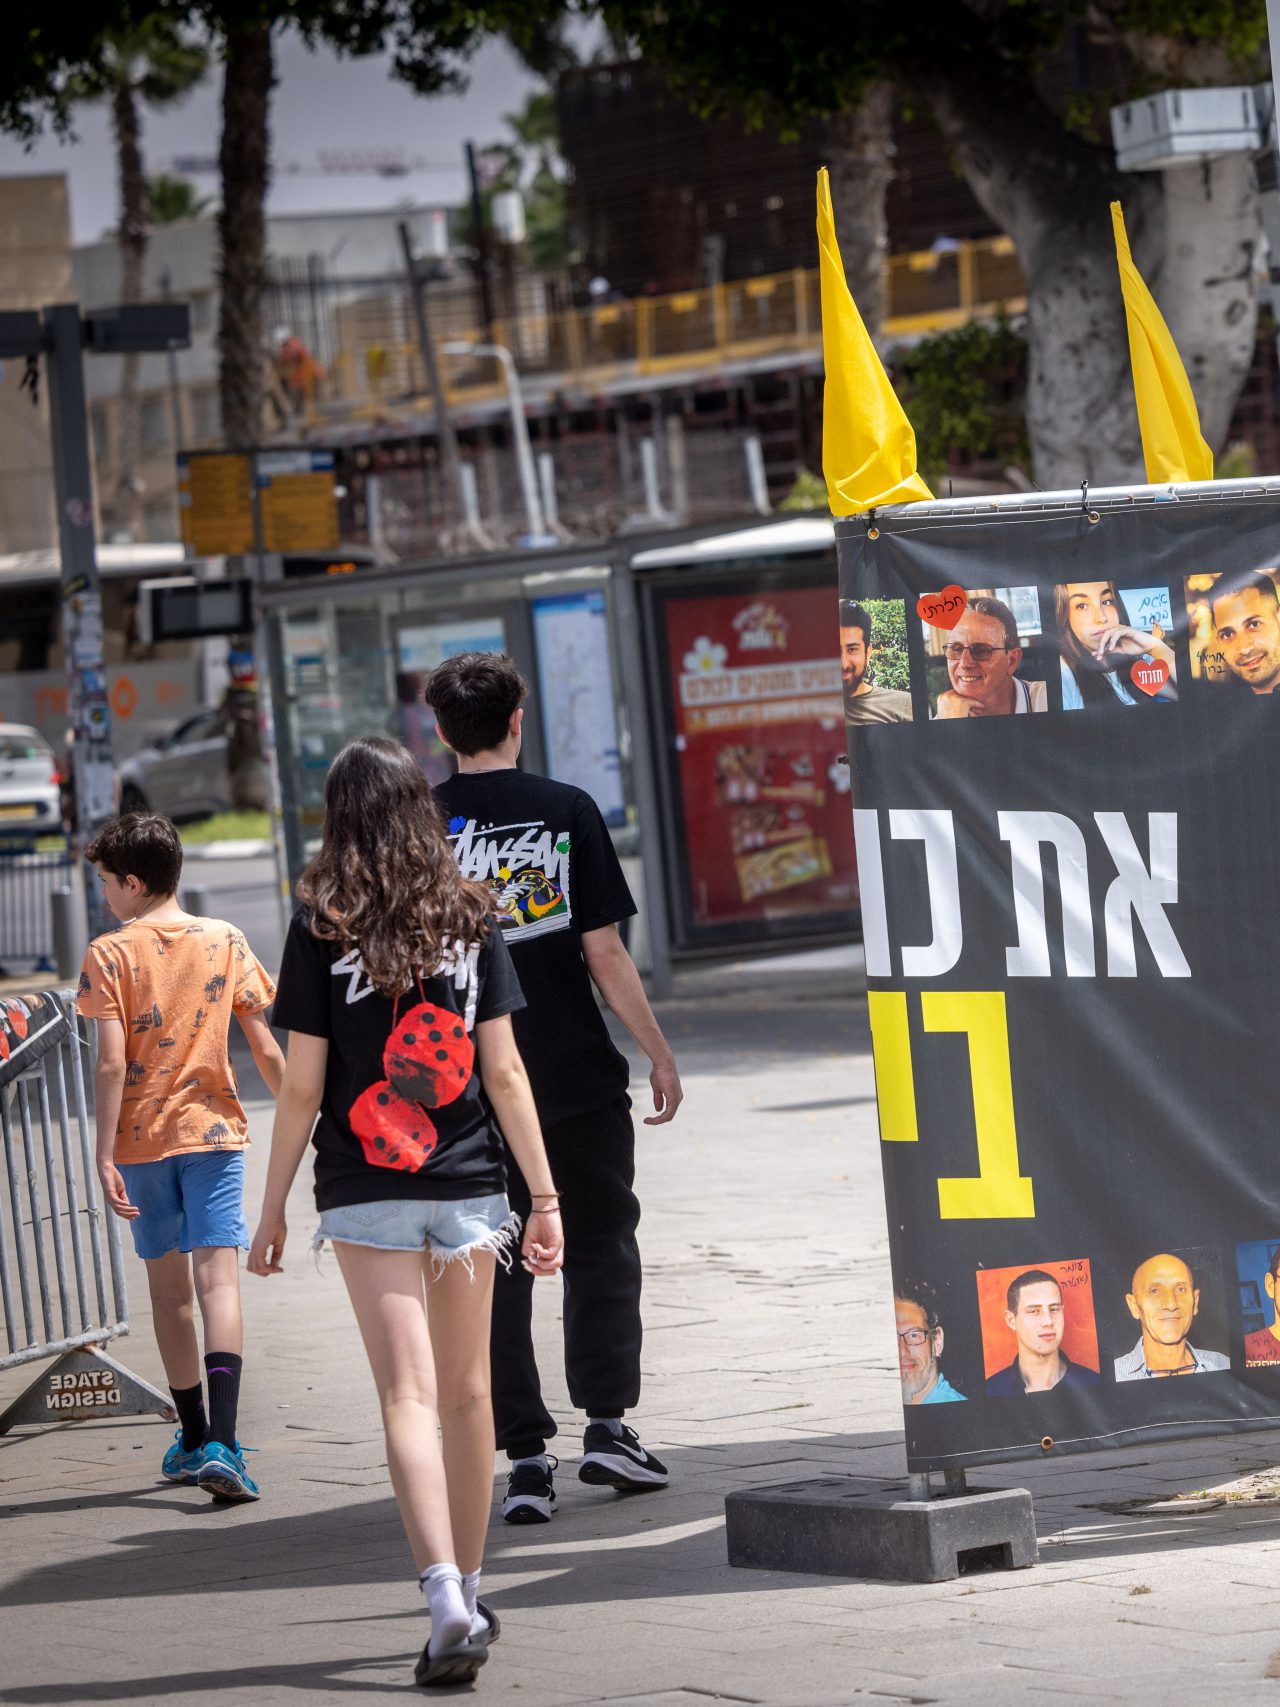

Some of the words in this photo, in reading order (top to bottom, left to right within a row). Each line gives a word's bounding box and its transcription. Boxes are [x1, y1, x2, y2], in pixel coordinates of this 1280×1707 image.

[1137, 668, 1163, 685] חזרתי
[997, 809, 1191, 978] את
[1059, 1260, 1083, 1273] עומר
